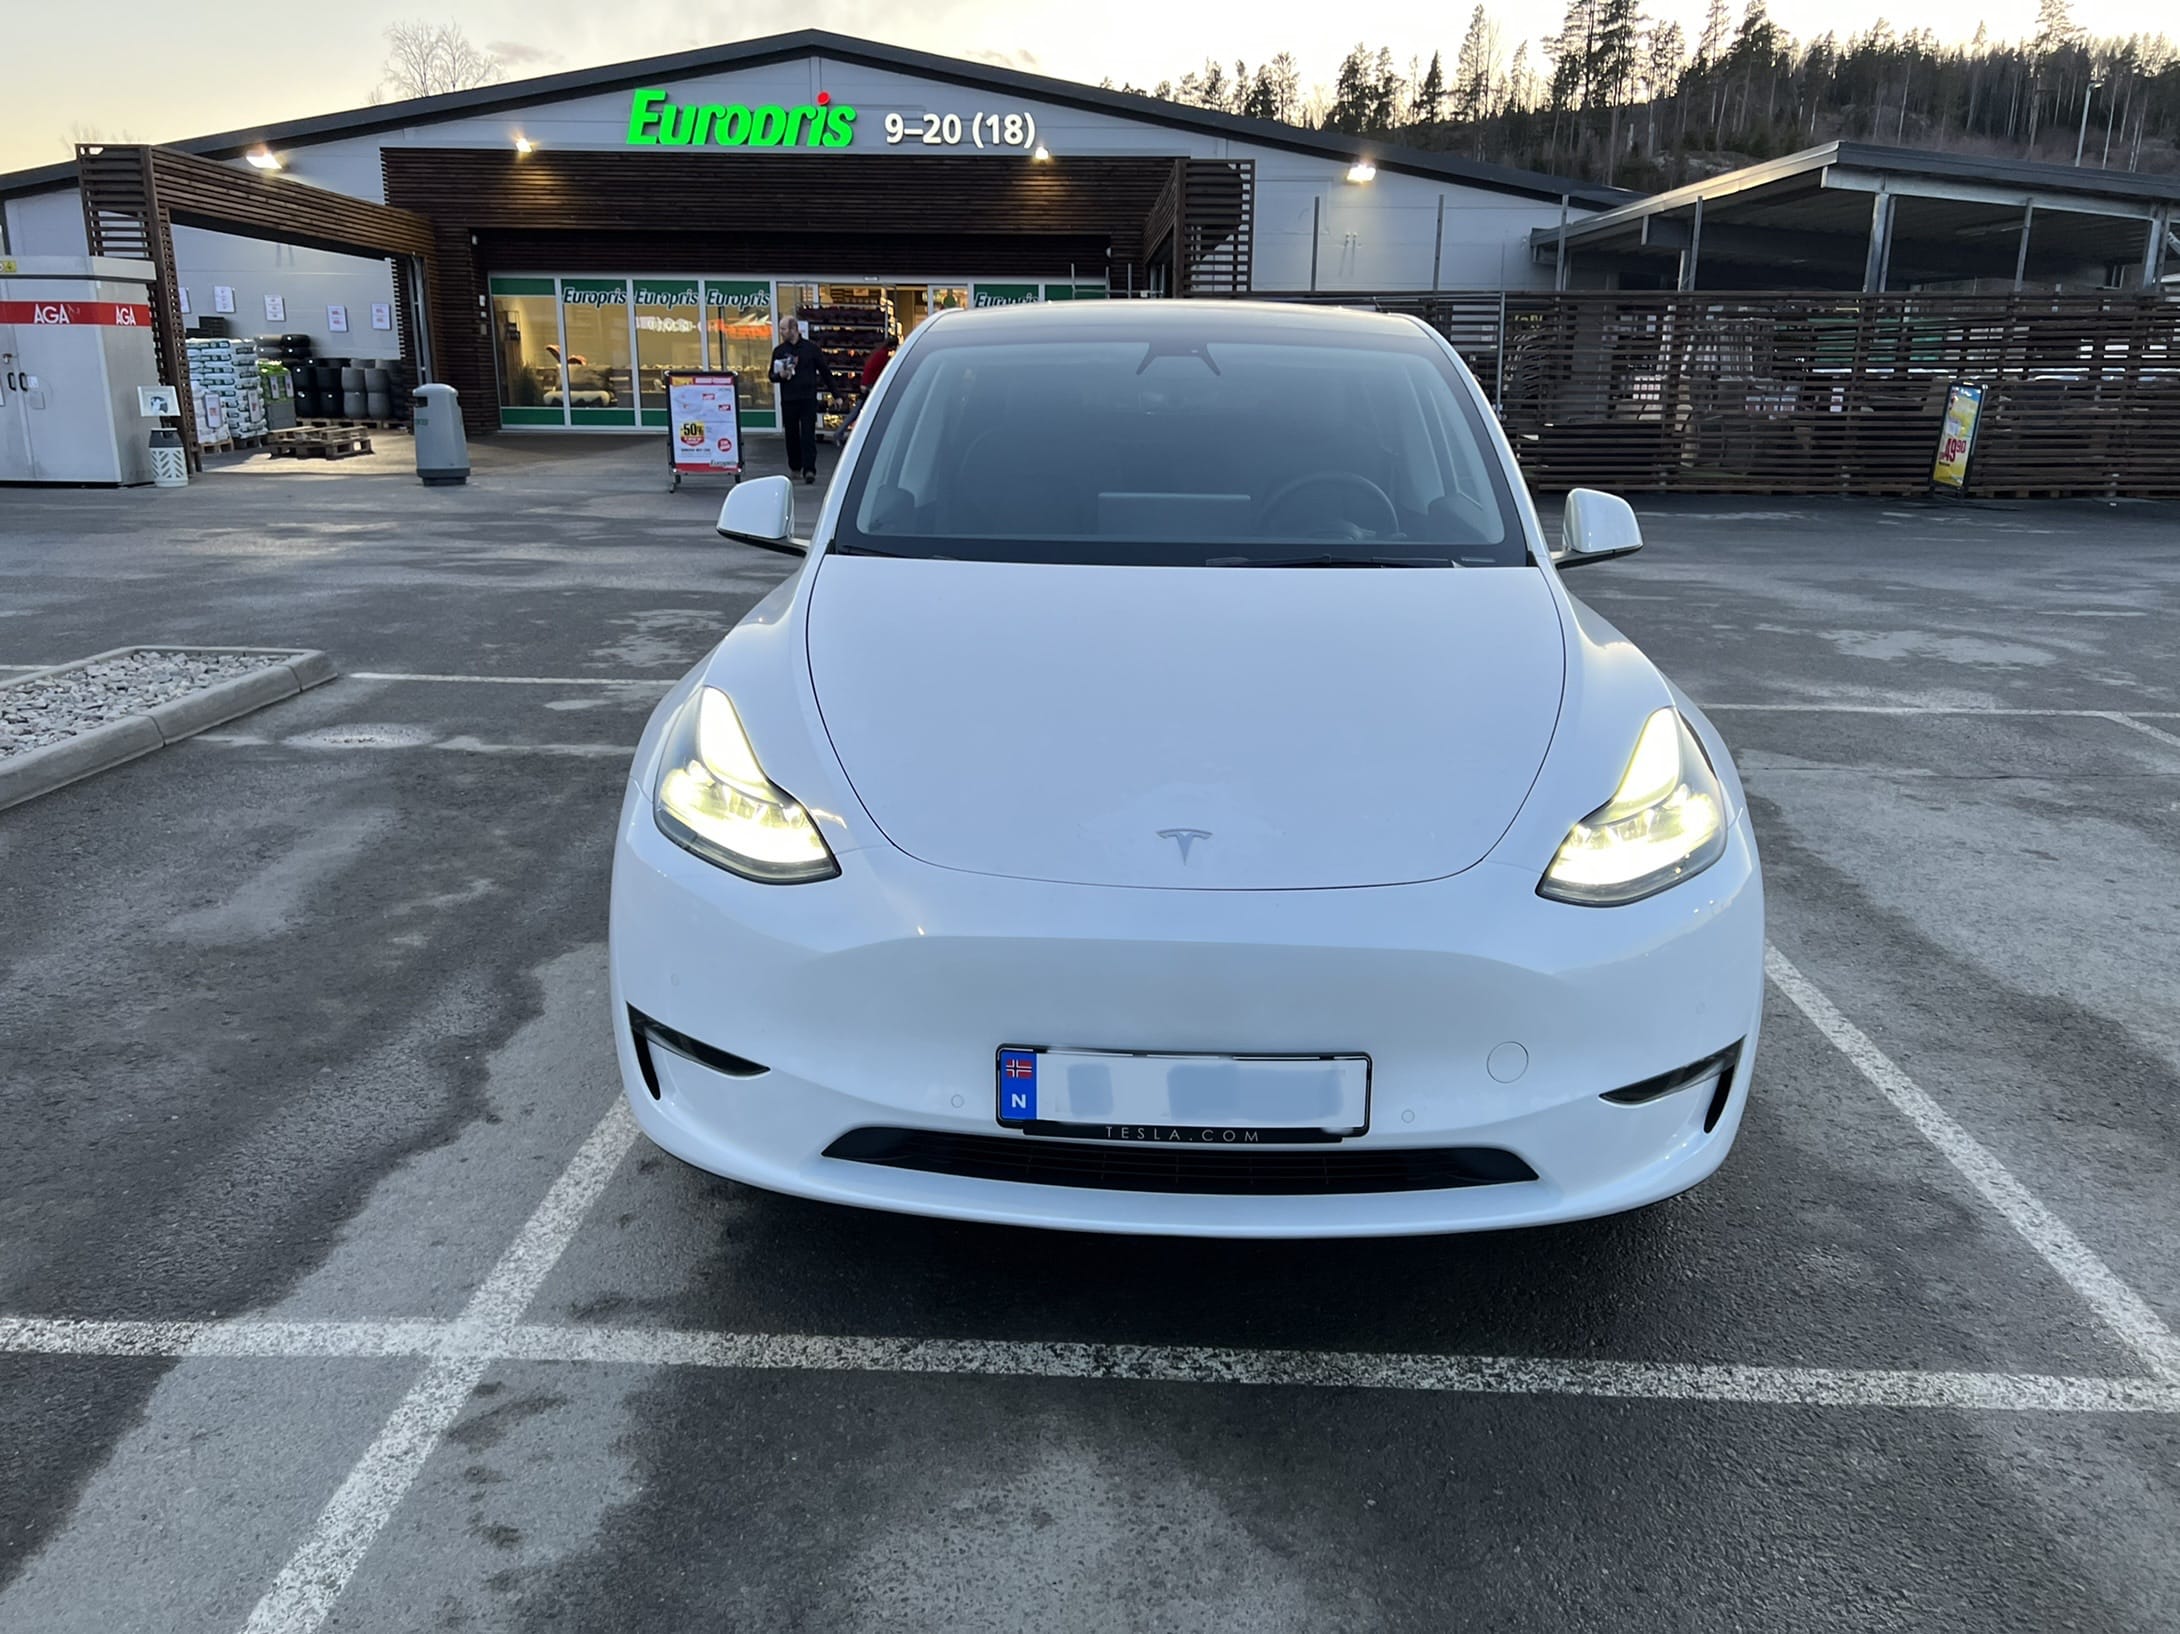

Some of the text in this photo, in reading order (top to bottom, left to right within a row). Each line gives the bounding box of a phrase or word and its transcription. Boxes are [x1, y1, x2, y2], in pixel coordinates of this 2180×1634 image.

[626, 88, 857, 148] Europris
[972, 111, 1036, 149] (18)
[563, 286, 628, 310] Europris
[635, 287, 699, 311] Europris
[706, 288, 771, 312] Europris
[34, 303, 71, 324] AGA
[115, 305, 137, 325] AGA
[1011, 1093, 1027, 1108] N
[1105, 1126, 1260, 1142] TESLA.COM
